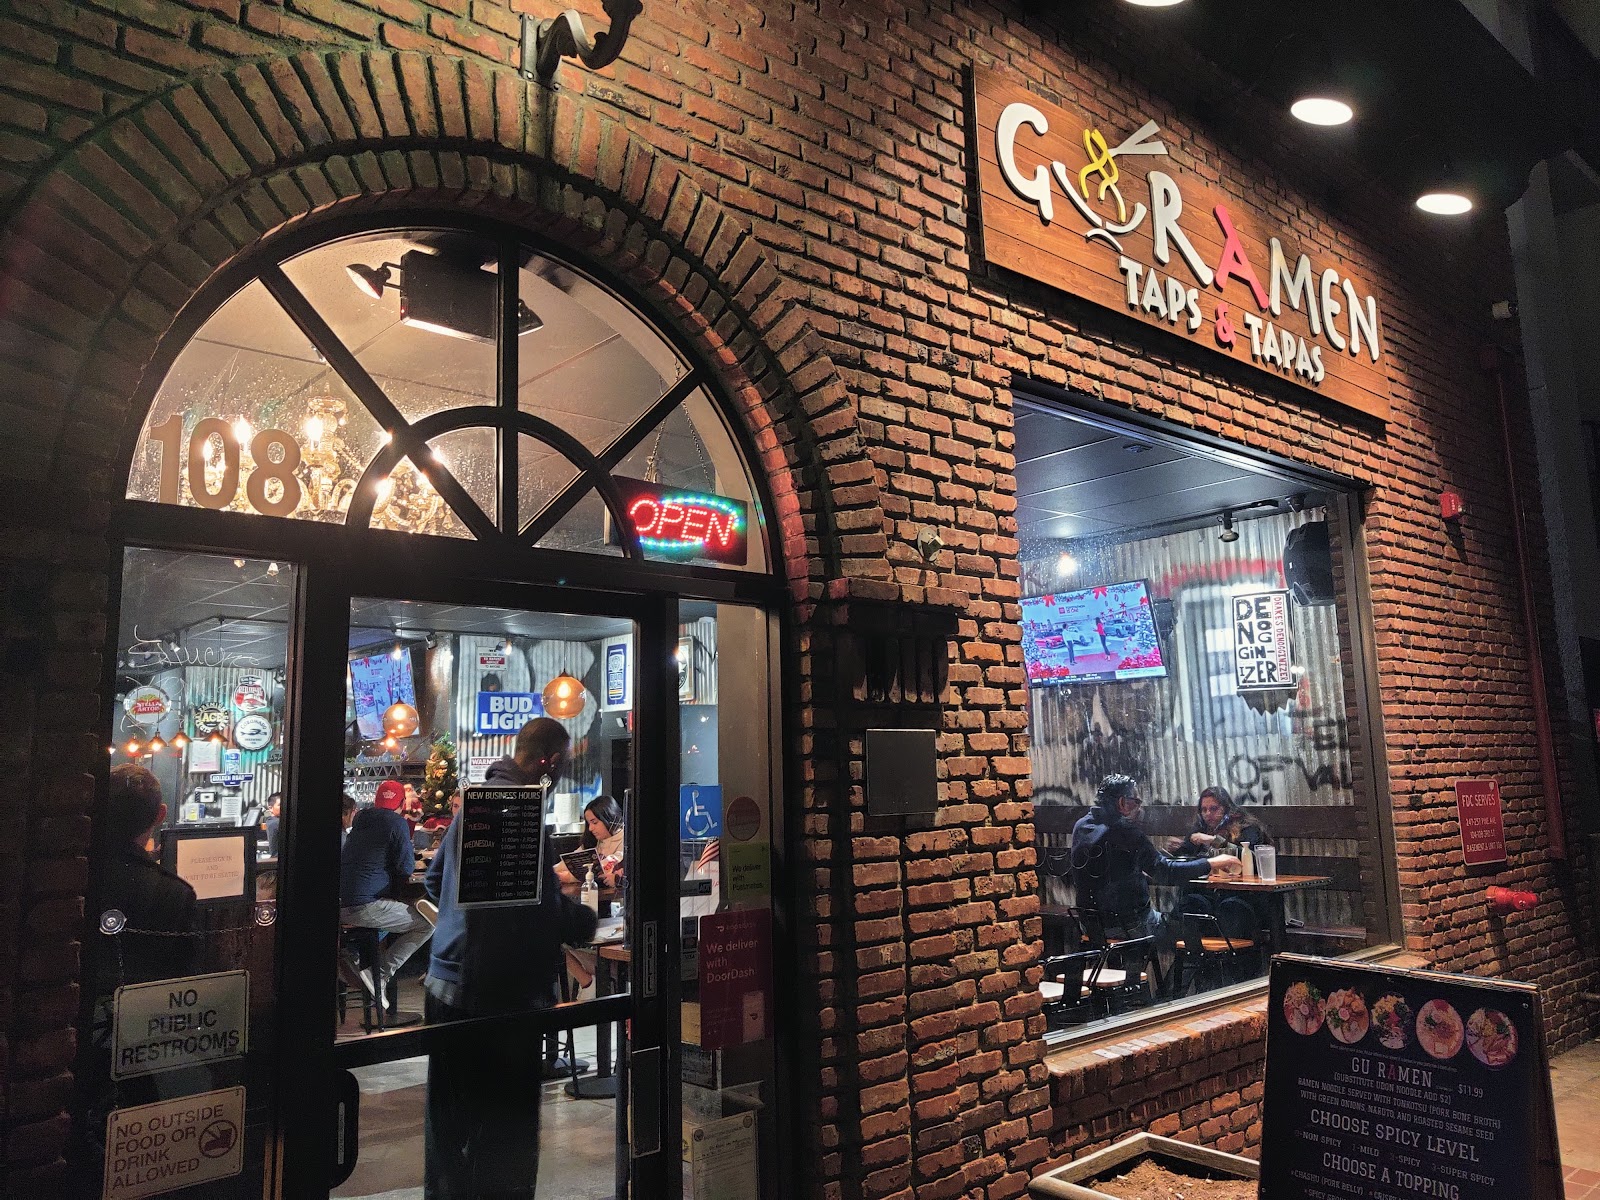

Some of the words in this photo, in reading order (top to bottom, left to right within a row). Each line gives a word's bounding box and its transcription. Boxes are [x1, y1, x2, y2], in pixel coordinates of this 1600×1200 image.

[1147, 171, 1380, 361] RAMEN
[1119, 255, 1203, 330] TAPS
[1214, 302, 1236, 347] &
[1245, 312, 1325, 383] TAPAS
[150, 415, 301, 516] 108
[630, 500, 733, 546] OPEN
[1236, 597, 1271, 620] DE
[1239, 660, 1277, 684] IZER
[202, 712, 224, 722] ACE
[490, 696, 533, 713] BUD
[467, 792, 484, 800] NEW
[485, 791, 516, 800] BUSINESS
[519, 791, 540, 800] HOURS
[1462, 794, 1474, 807] FDC
[1474, 794, 1496, 807] SERVES
[468, 823, 491, 831] TUESDAY
[464, 840, 495, 849] WEDNESDAY
[705, 943, 724, 954] We
[725, 939, 758, 952] deliver
[705, 956, 728, 969] with
[707, 967, 755, 984] DoorDash
[169, 989, 198, 1009] NO
[148, 1009, 217, 1036] PUBLIC
[122, 1030, 240, 1066] RESTROOMS
[1334, 1071, 1374, 1088] (SUBSTITUTE
[1396, 1085, 1422, 1099] NOODLE
[1423, 1091, 1438, 1102] ADD
[1351, 1057, 1370, 1074] GU
[1377, 1062, 1432, 1088] RAMEN
[1457, 1083, 1484, 1099] $11.99
[1298, 1077, 1320, 1089] RAMEN
[1321, 1082, 1346, 1095] NOODLE
[1347, 1087, 1372, 1100] SERVED
[1373, 1093, 1391, 1104] WITH
[1452, 1110, 1472, 1123] BONE
[1300, 1089, 1317, 1100] WITH
[1318, 1093, 1339, 1106] GREEN
[1396, 1111, 1412, 1122] AND
[1413, 1114, 1444, 1129] ROASTED
[1445, 1121, 1474, 1137] SESAME
[1475, 1129, 1494, 1141] SEED
[116, 1121, 142, 1138] NO
[148, 1104, 224, 1131] OUTSIDE
[1311, 1109, 1370, 1136] CHOOSE
[1375, 1123, 1421, 1148] SPICY
[1427, 1135, 1479, 1162] LEVEL
[115, 1133, 166, 1156] FOOD
[171, 1126, 197, 1143] OR
[112, 1158, 199, 1190] ALLOWED
[114, 1148, 170, 1173] DRINK
[1321, 1136, 1342, 1148] SPICY
[1470, 1172, 1495, 1187] SPICY
[1323, 1152, 1376, 1180] CHOOSE
[1381, 1167, 1391, 1184] A
[1395, 1170, 1459, 1200] TOPPING
